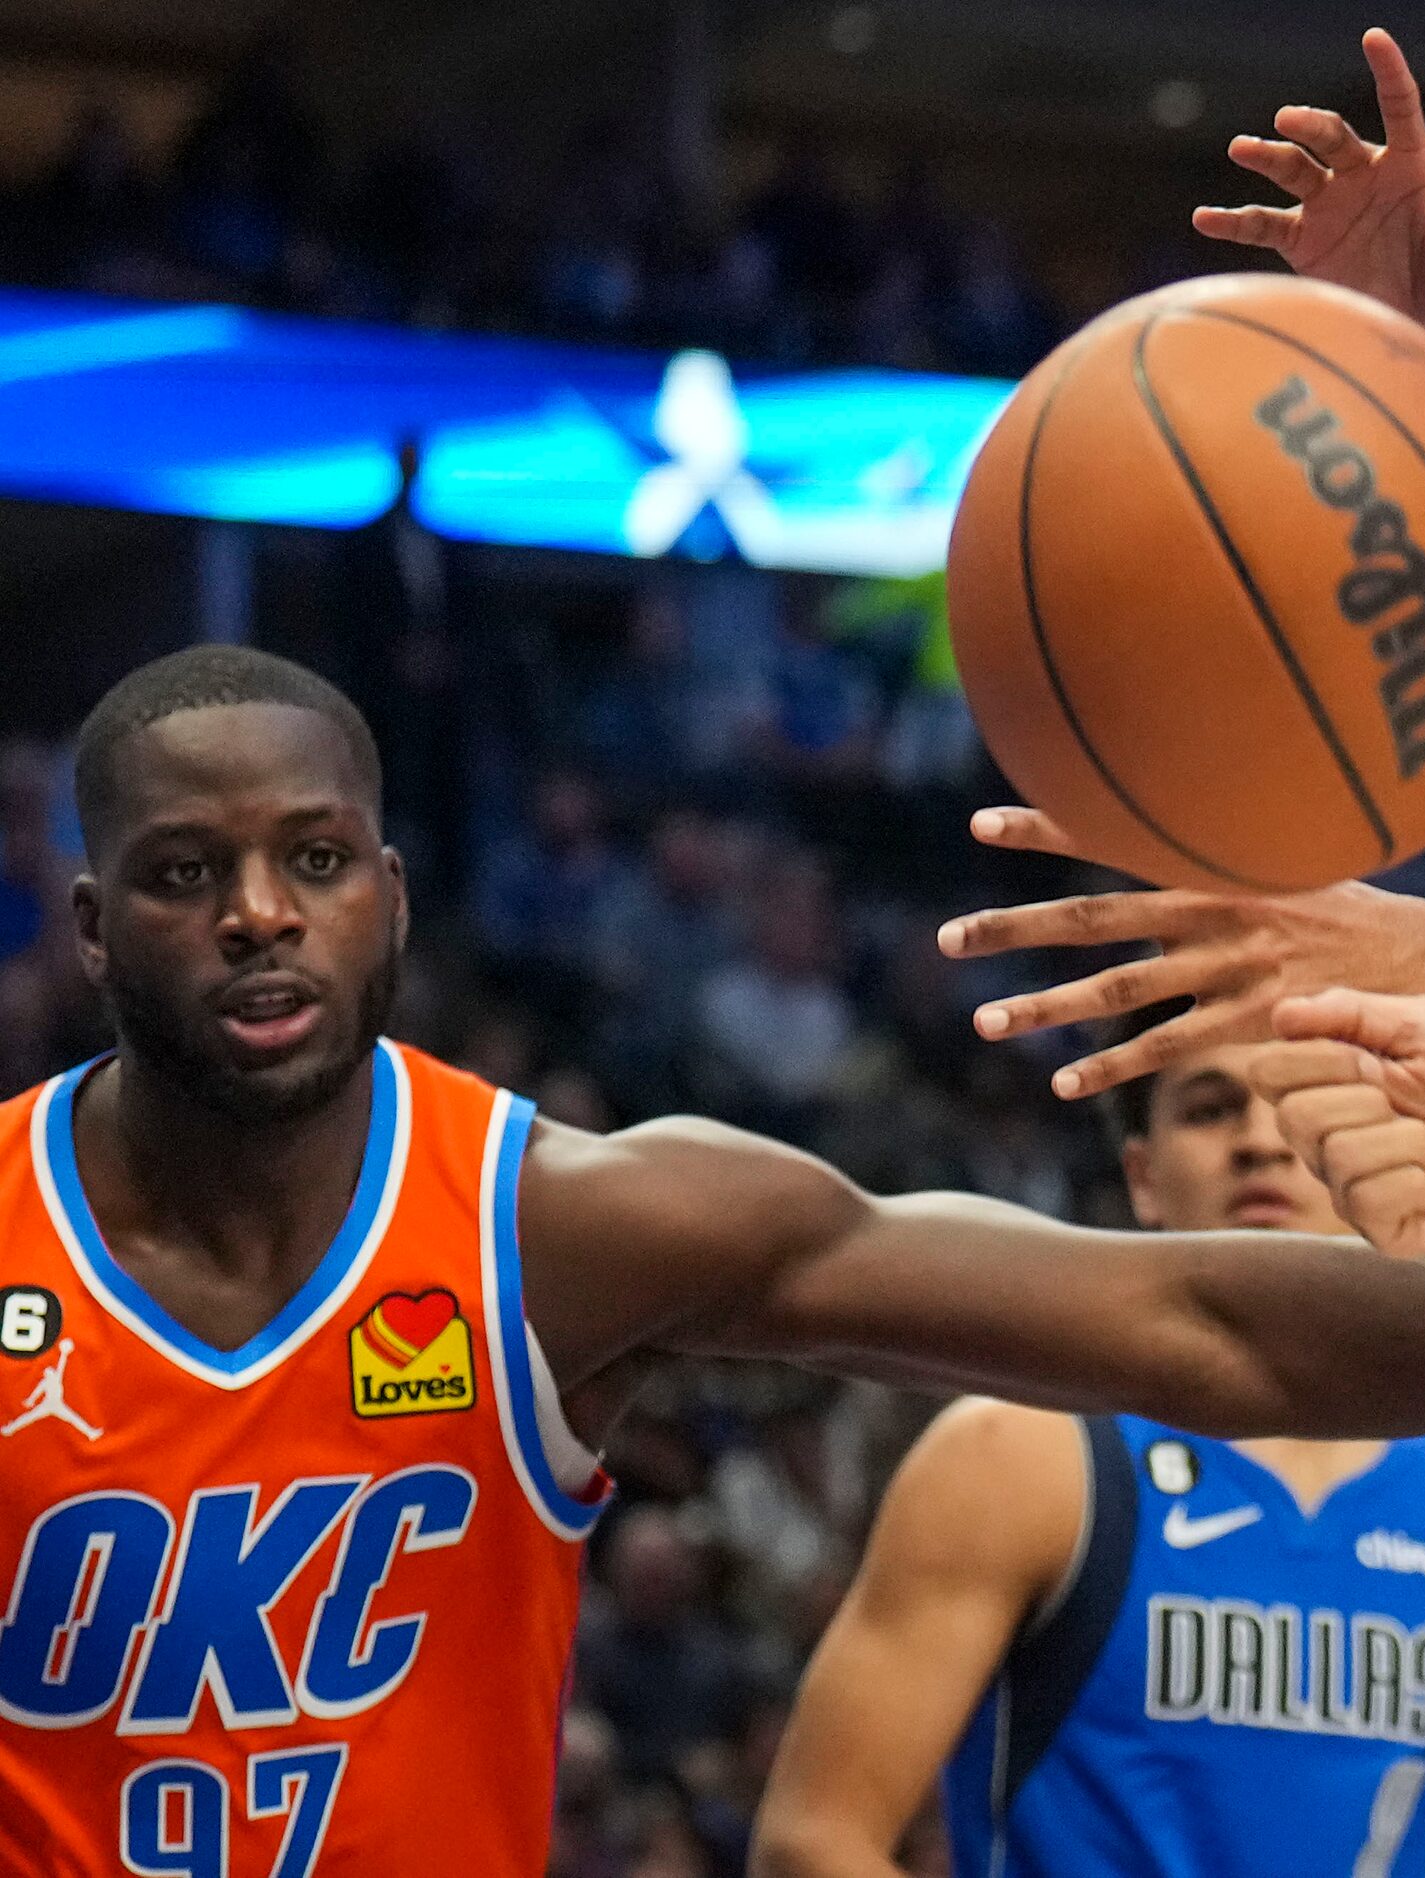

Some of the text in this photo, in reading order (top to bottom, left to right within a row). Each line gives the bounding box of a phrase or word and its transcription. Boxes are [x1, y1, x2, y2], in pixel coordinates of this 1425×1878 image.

[1, 1292, 48, 1352] 6
[0, 1462, 478, 1736] OKC
[120, 1742, 349, 1878] 97
